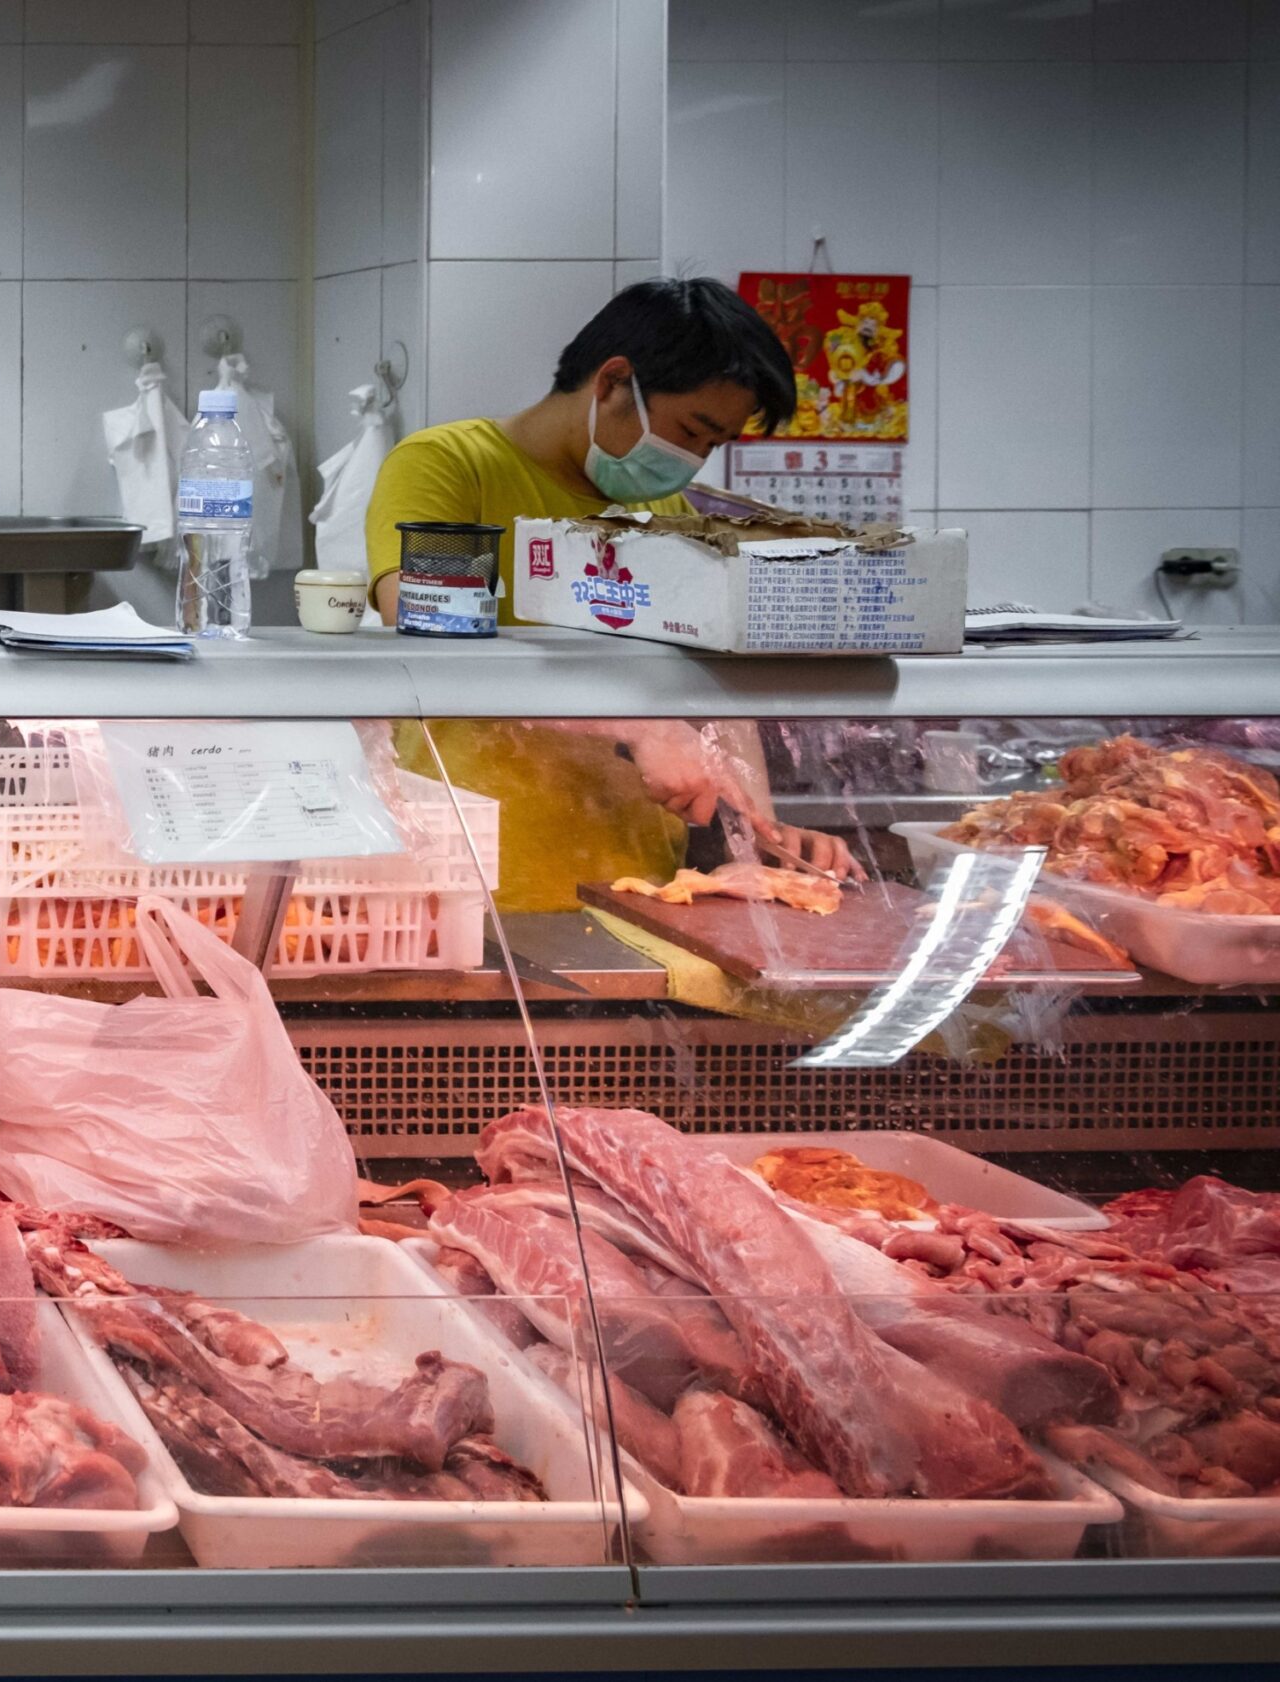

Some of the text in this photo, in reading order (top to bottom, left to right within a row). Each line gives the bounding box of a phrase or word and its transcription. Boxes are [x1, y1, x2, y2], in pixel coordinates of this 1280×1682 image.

[814, 450, 828, 471] 3
[401, 589, 450, 603] ORTALAPICES
[570, 577, 652, 608] 双汇王中王
[147, 744, 174, 758] 猪肉
[190, 744, 222, 756] cerdo
